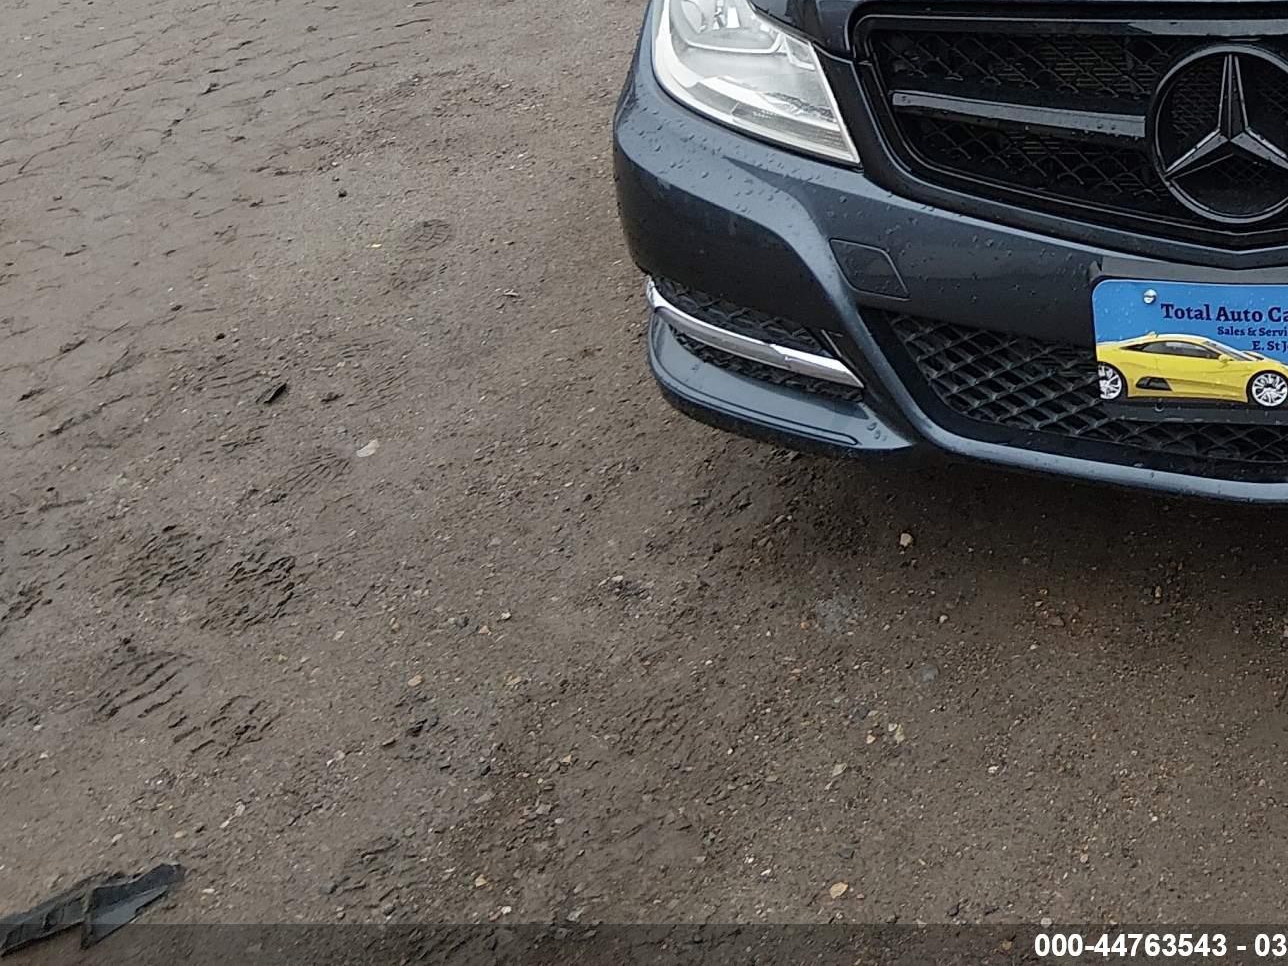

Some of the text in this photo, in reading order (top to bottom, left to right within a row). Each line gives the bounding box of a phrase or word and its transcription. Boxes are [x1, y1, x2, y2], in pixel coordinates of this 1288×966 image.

[1161, 303, 1212, 321] Total
[1216, 306, 1263, 323] Auto
[1217, 326, 1246, 336] Sales
[1247, 326, 1257, 336] &
[1252, 340, 1265, 351] E.
